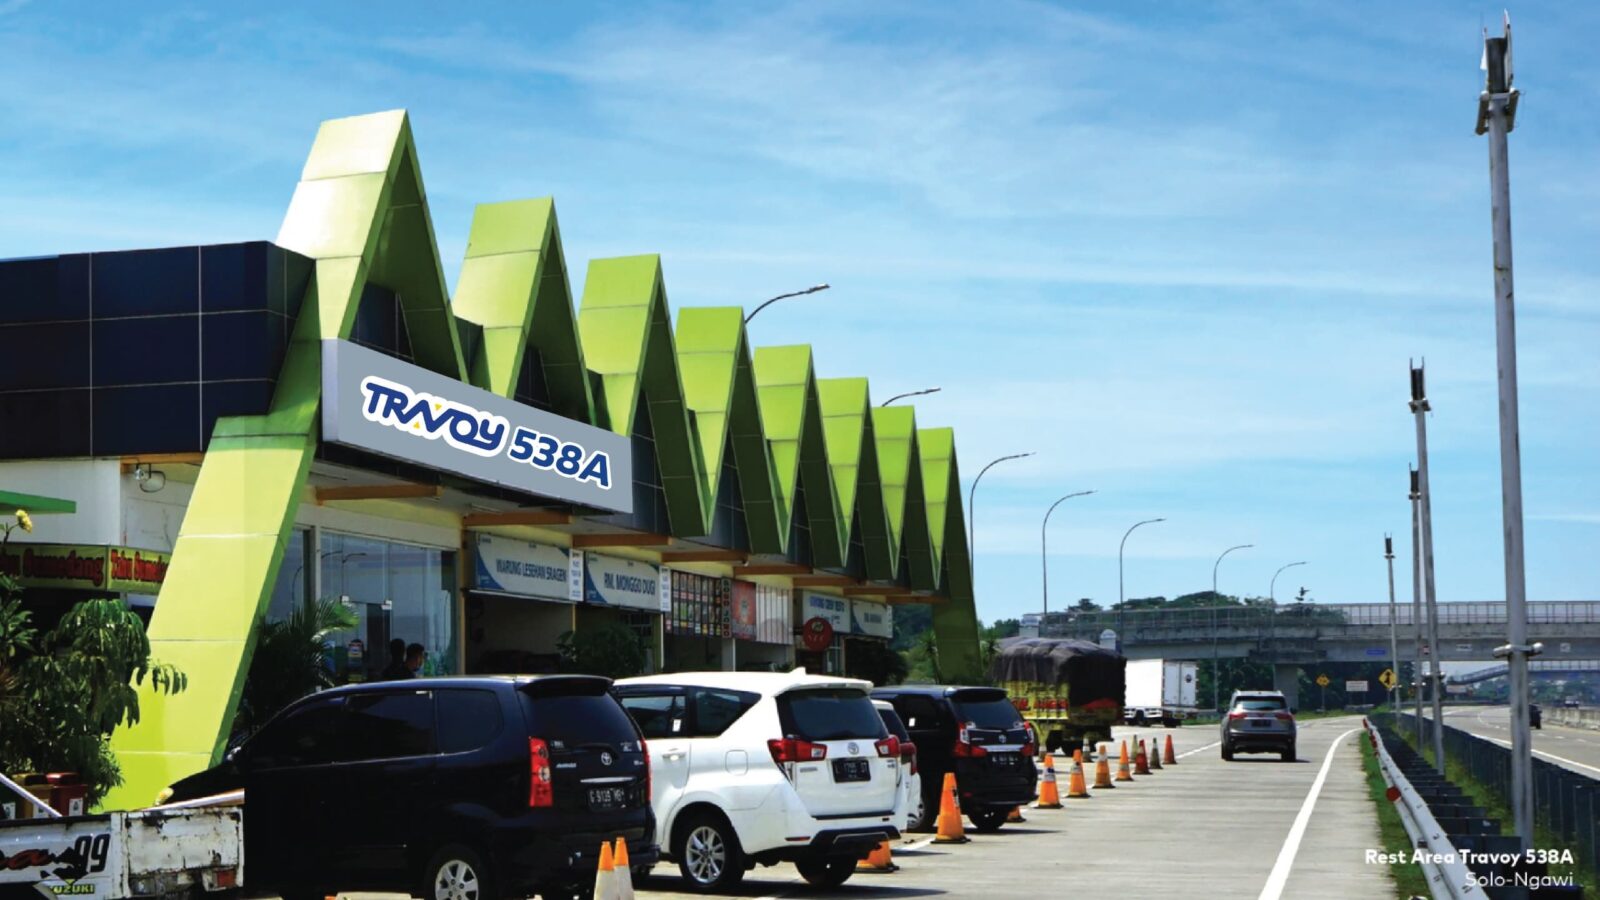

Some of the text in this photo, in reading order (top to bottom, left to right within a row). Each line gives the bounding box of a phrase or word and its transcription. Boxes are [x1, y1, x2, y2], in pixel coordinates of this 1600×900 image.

[365, 382, 610, 487] TRAVOY 538A
[74, 833, 111, 873] 99
